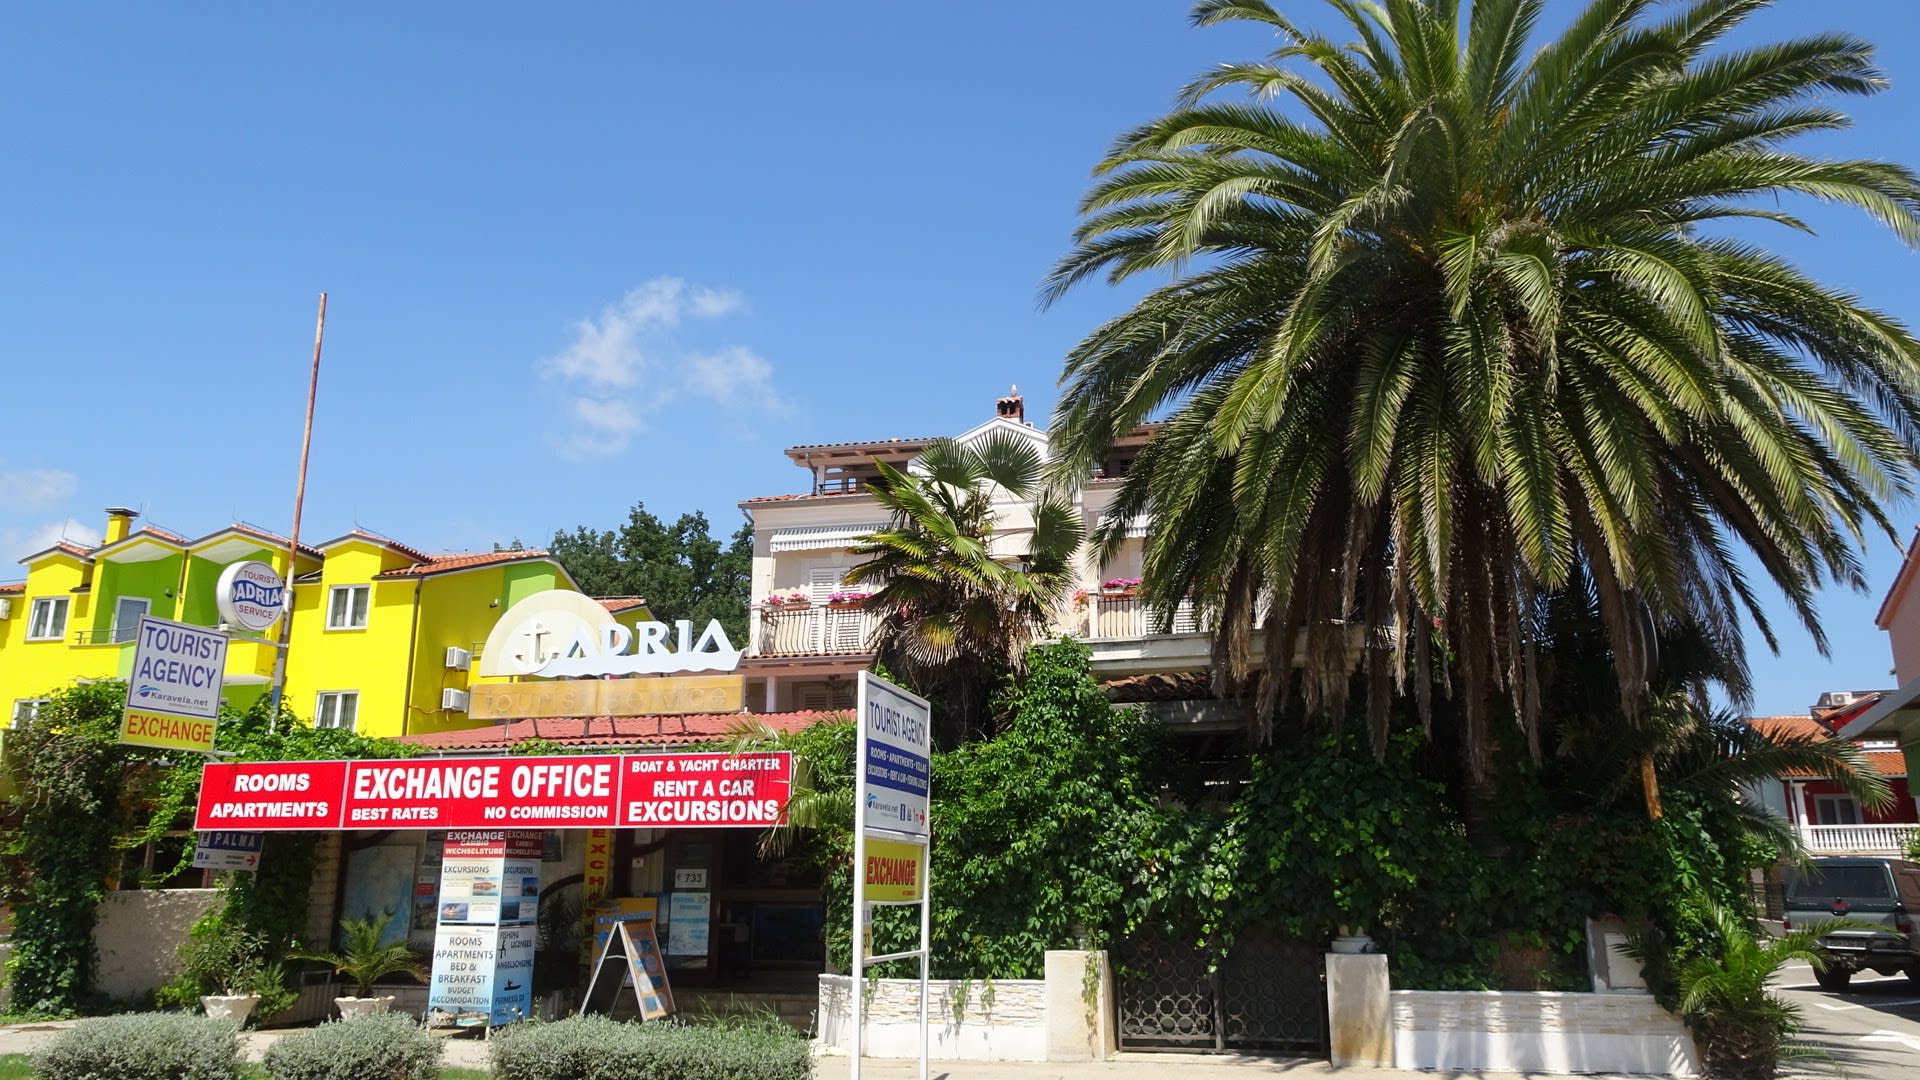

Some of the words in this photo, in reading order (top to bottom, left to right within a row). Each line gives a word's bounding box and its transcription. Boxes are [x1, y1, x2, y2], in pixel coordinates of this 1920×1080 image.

[244, 570, 276, 584] TOURIST
[235, 582, 281, 605] ADRIA
[239, 604, 273, 619] SERVICE
[145, 626, 223, 660] TOURIST
[563, 618, 737, 660] ADRIA
[139, 657, 216, 689] AGENCY
[151, 692, 208, 706] Karavela.net
[127, 714, 213, 743] EXCHANGE
[869, 701, 900, 738] TOURIST
[902, 715, 926, 747] AGENCY
[631, 760, 664, 773] BOAT
[666, 760, 676, 772] &
[679, 759, 719, 772] YACHT
[722, 758, 781, 771] CHARTER
[870, 746, 887, 761] ROOMS
[889, 752, 914, 770] APARTMENTS
[234, 774, 310, 792] ROOMS
[353, 767, 500, 800] EXCHANGE
[511, 764, 611, 798] OFFICE
[653, 780, 699, 798] RENT
[702, 780, 716, 797] A
[719, 779, 754, 797] CAR
[210, 802, 328, 818] APARTMENTS
[351, 808, 387, 821] BEST
[391, 807, 439, 820] RATES
[484, 807, 506, 819] NO
[510, 806, 608, 819] COMMISSION
[628, 800, 779, 822] EXCURSIONS
[214, 832, 255, 848] PALMA
[447, 831, 505, 840] EXCHANGE
[507, 830, 543, 840] EXCHANGE
[445, 847, 503, 855] WECHSELSTUBE
[444, 866, 490, 874] EXCURSIONS
[866, 856, 916, 886] EXCHANGE
[449, 937, 482, 946] ROOMS
[435, 950, 494, 960] APARTMENTS
[450, 962, 467, 971] BED
[469, 963, 477, 971] &
[438, 975, 487, 984] BREAKFAST
[431, 996, 490, 1004] ACCOMODATION
